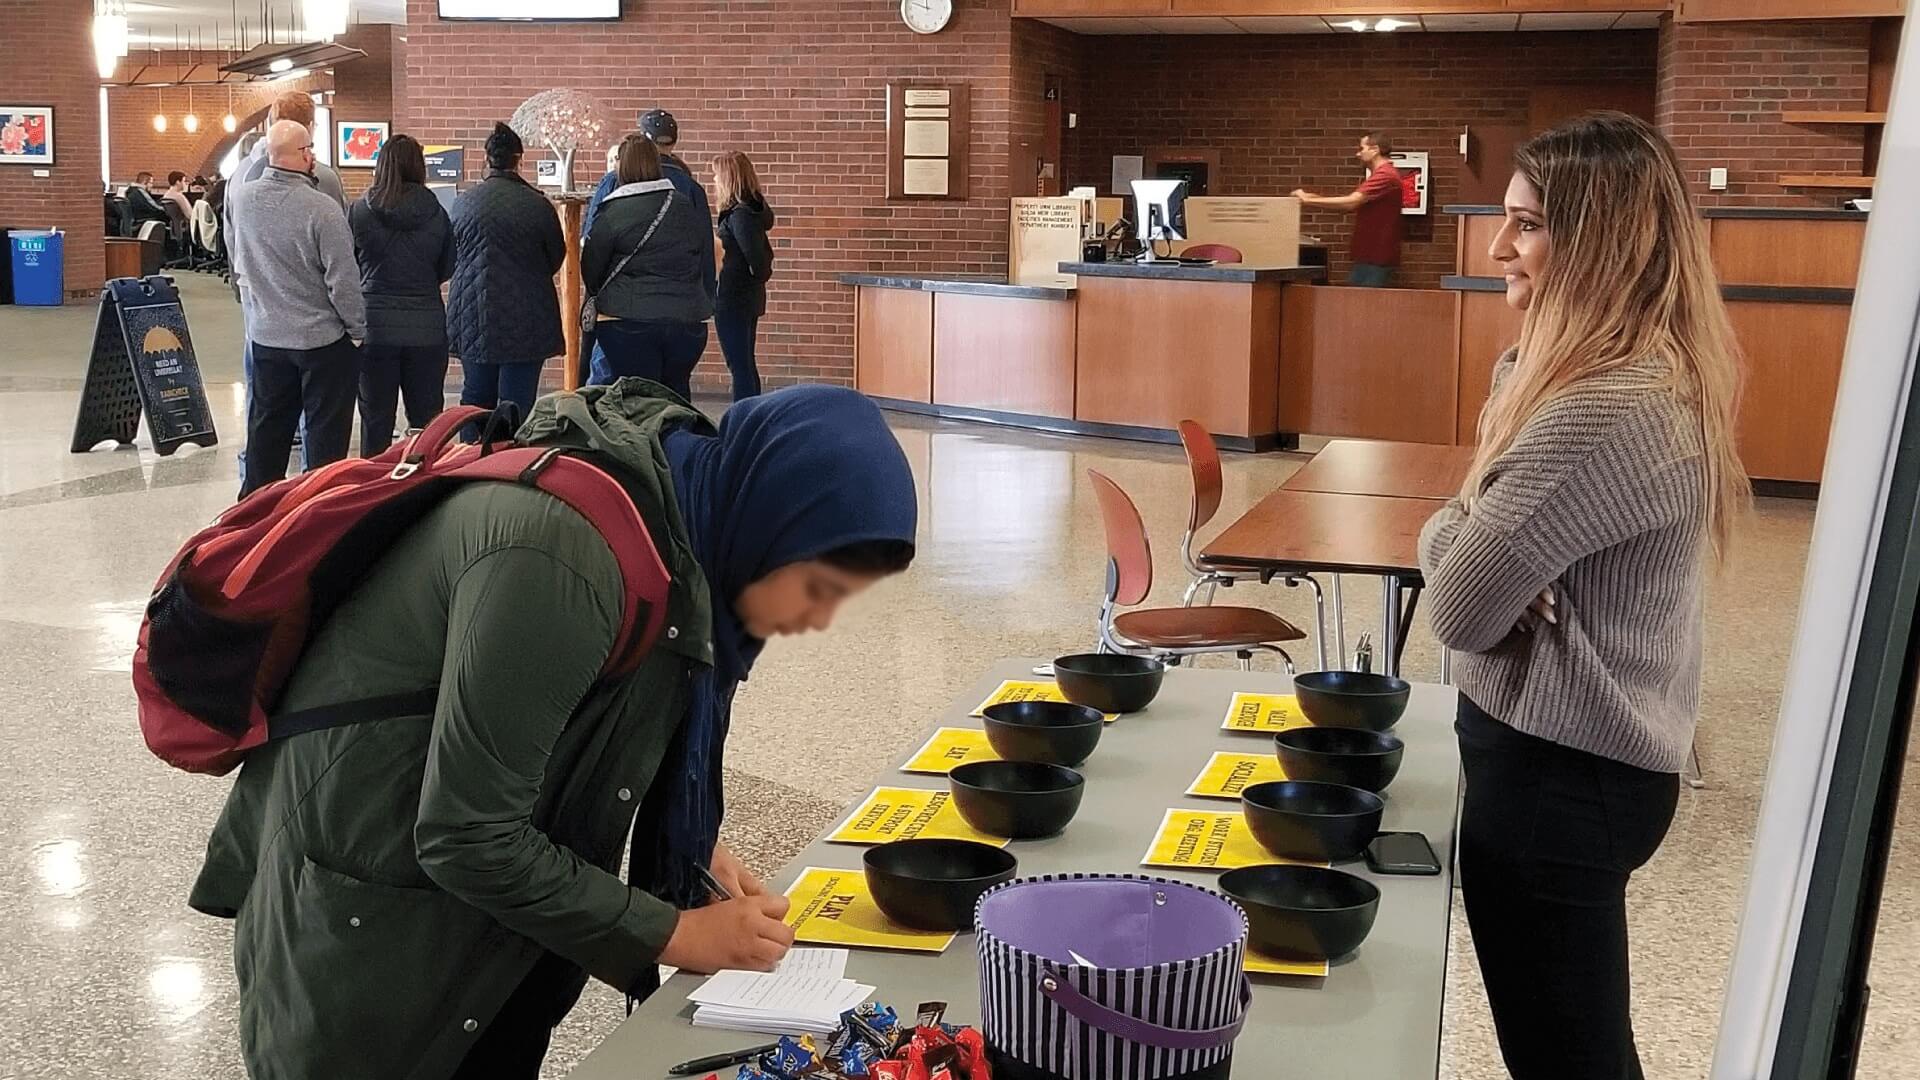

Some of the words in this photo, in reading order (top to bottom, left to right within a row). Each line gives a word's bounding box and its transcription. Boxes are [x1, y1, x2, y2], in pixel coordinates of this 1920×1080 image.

[1047, 88, 1056, 101] 4
[944, 746, 970, 760] EAT
[815, 894, 856, 921] PLAY
